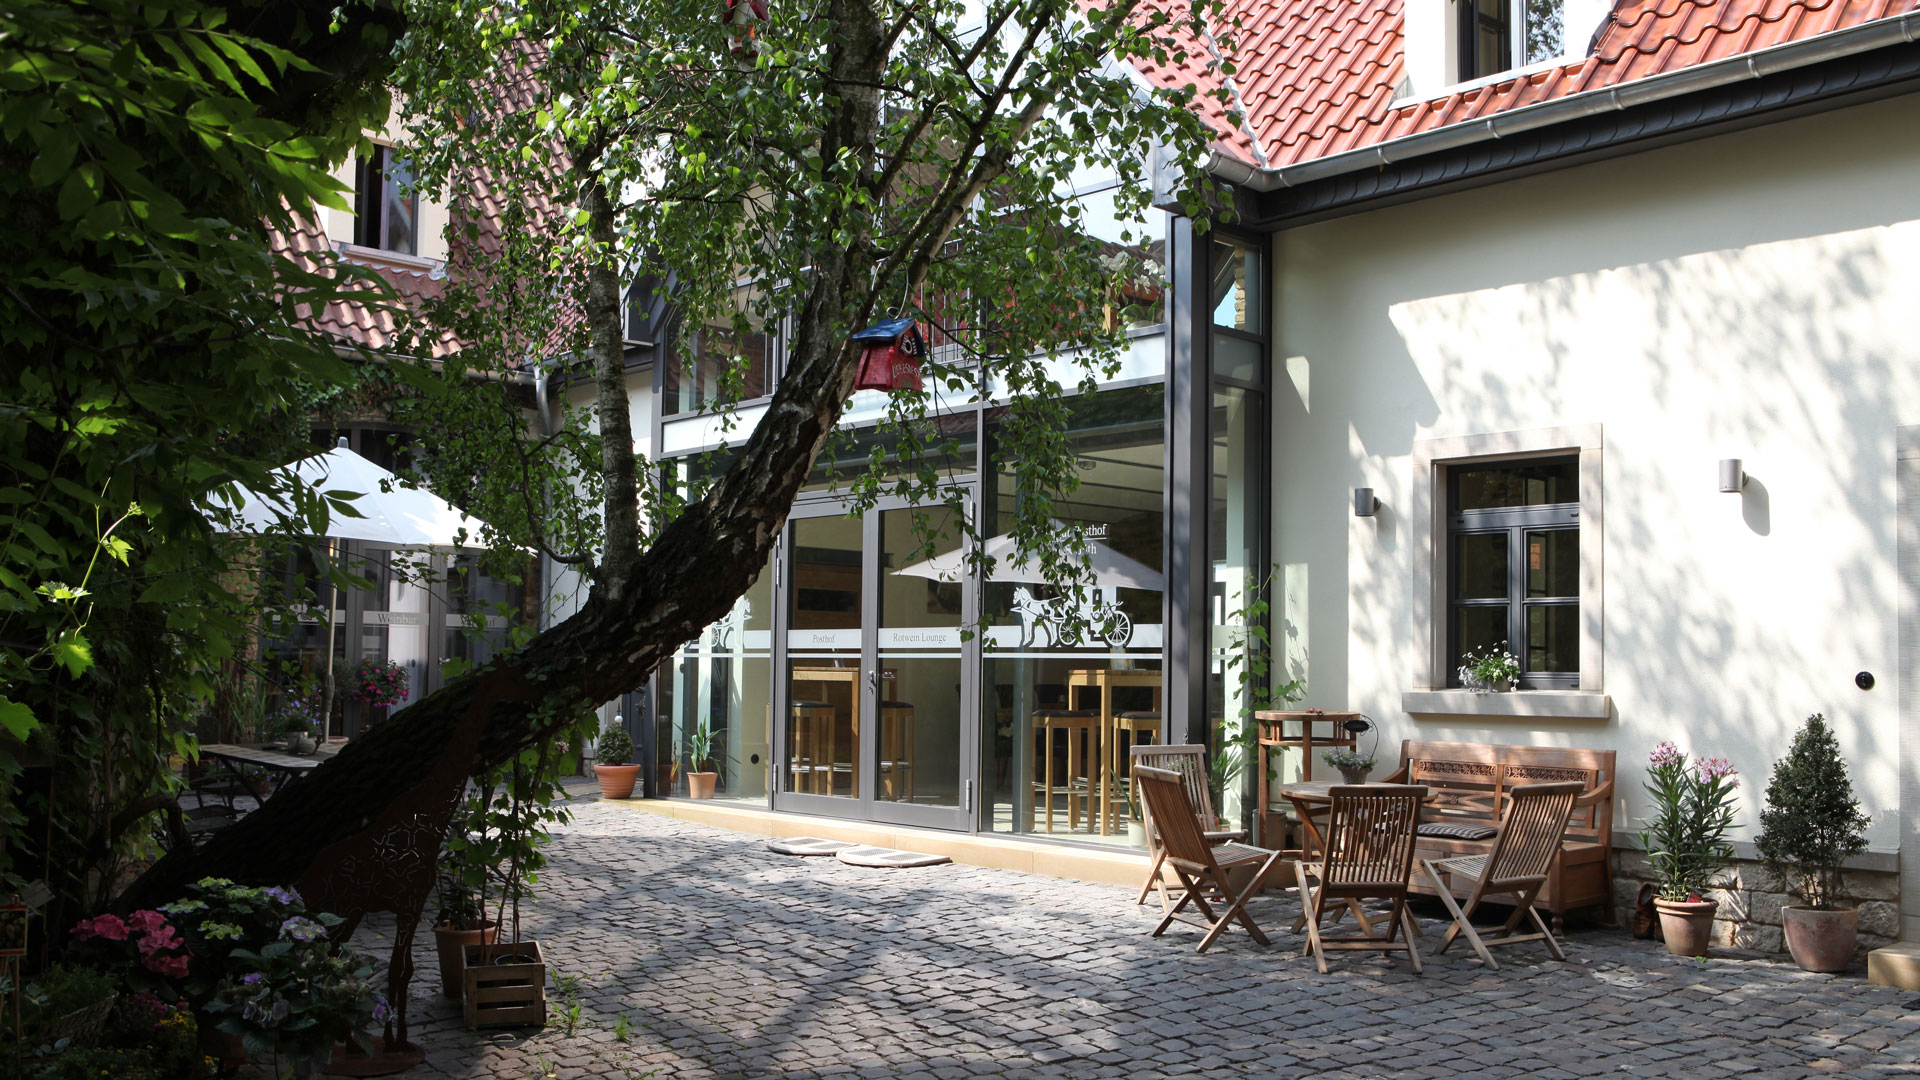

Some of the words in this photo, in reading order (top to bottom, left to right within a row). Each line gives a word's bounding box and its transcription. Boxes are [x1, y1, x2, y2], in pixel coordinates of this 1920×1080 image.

[1073, 523, 1108, 537] sthof
[812, 633, 836, 644] Posthof
[893, 632, 920, 642] Rotwein
[921, 632, 947, 645] Lounge
